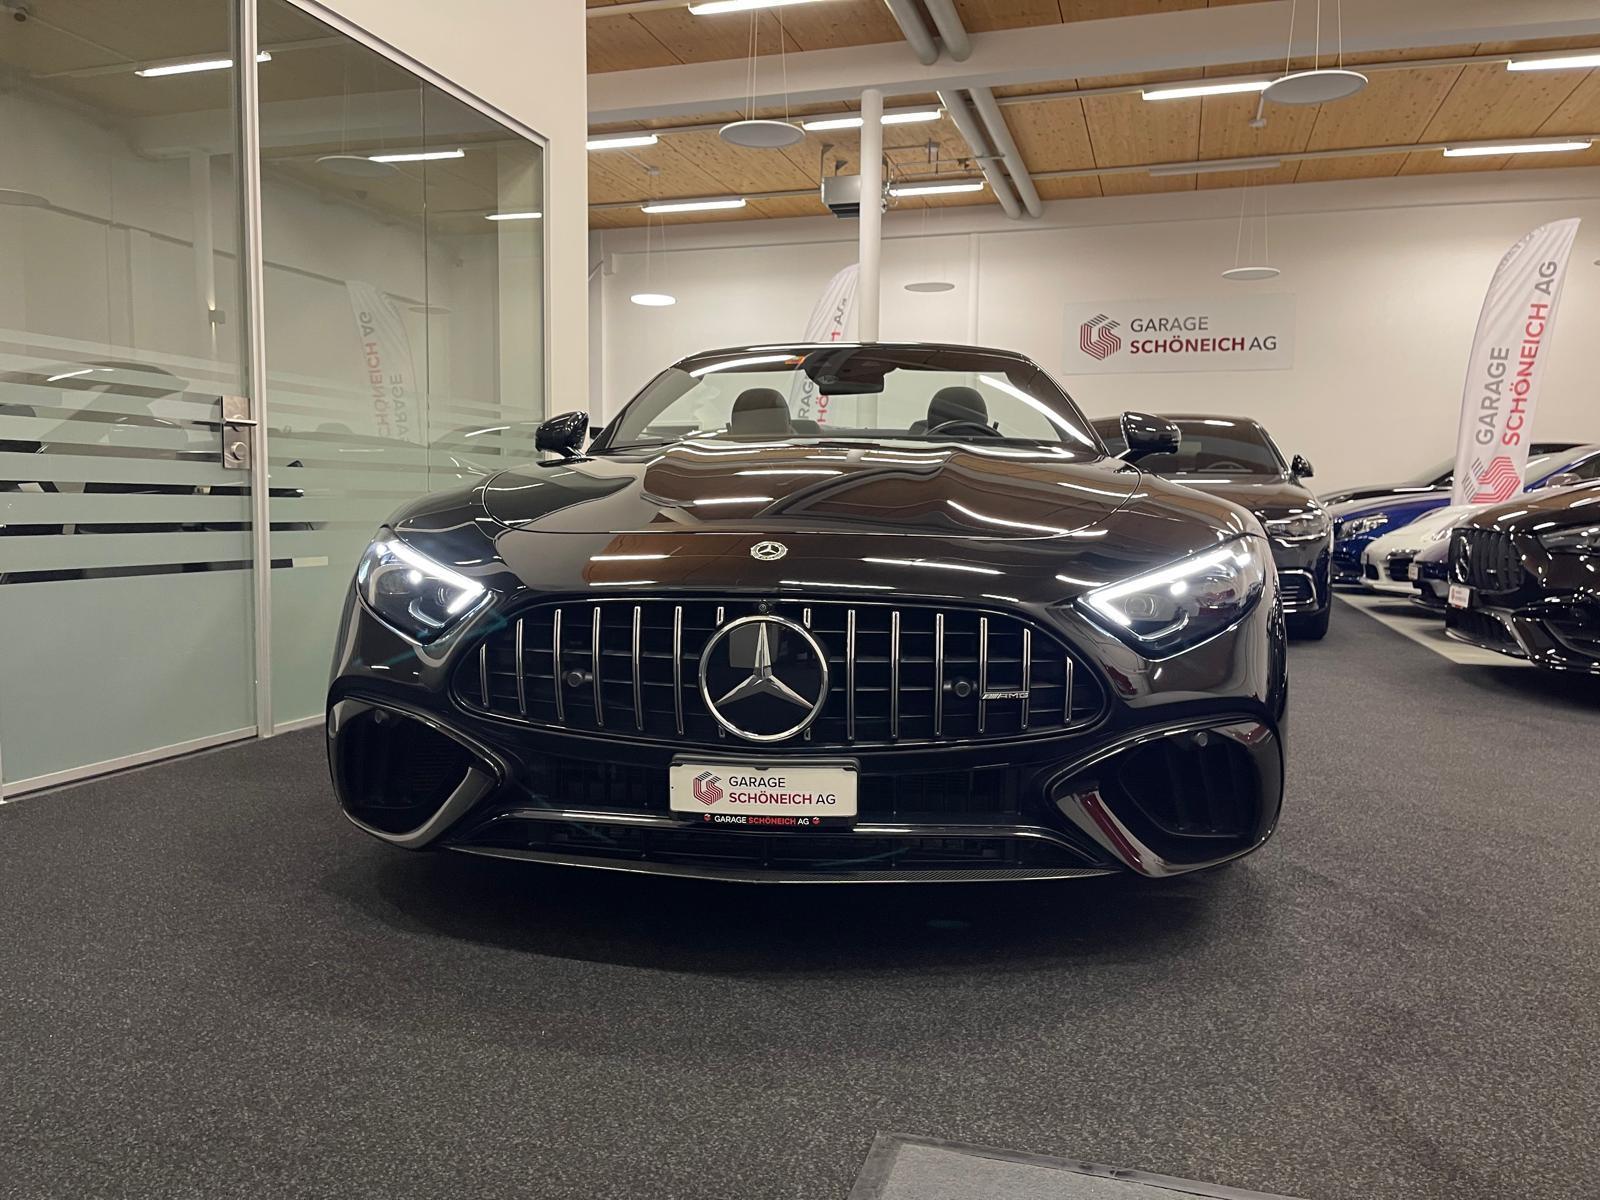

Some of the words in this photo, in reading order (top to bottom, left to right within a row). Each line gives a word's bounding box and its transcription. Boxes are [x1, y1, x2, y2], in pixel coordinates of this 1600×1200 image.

[1130, 316, 1208, 332] GARAGE
[1130, 336, 1245, 354] SCHÖNEICH
[1249, 336, 1277, 351] AG
[1502, 303, 1548, 446] SCHÖNEICH
[1534, 261, 1557, 295] AG
[1475, 347, 1509, 445] GARAGE
[728, 776, 786, 788] GARAGE
[728, 791, 812, 805] SCHÖNEICH
[815, 794, 836, 805] AG
[714, 815, 747, 824] GARAGE
[748, 816, 796, 826] SCHÖNEICH
[797, 817, 810, 826] AG
